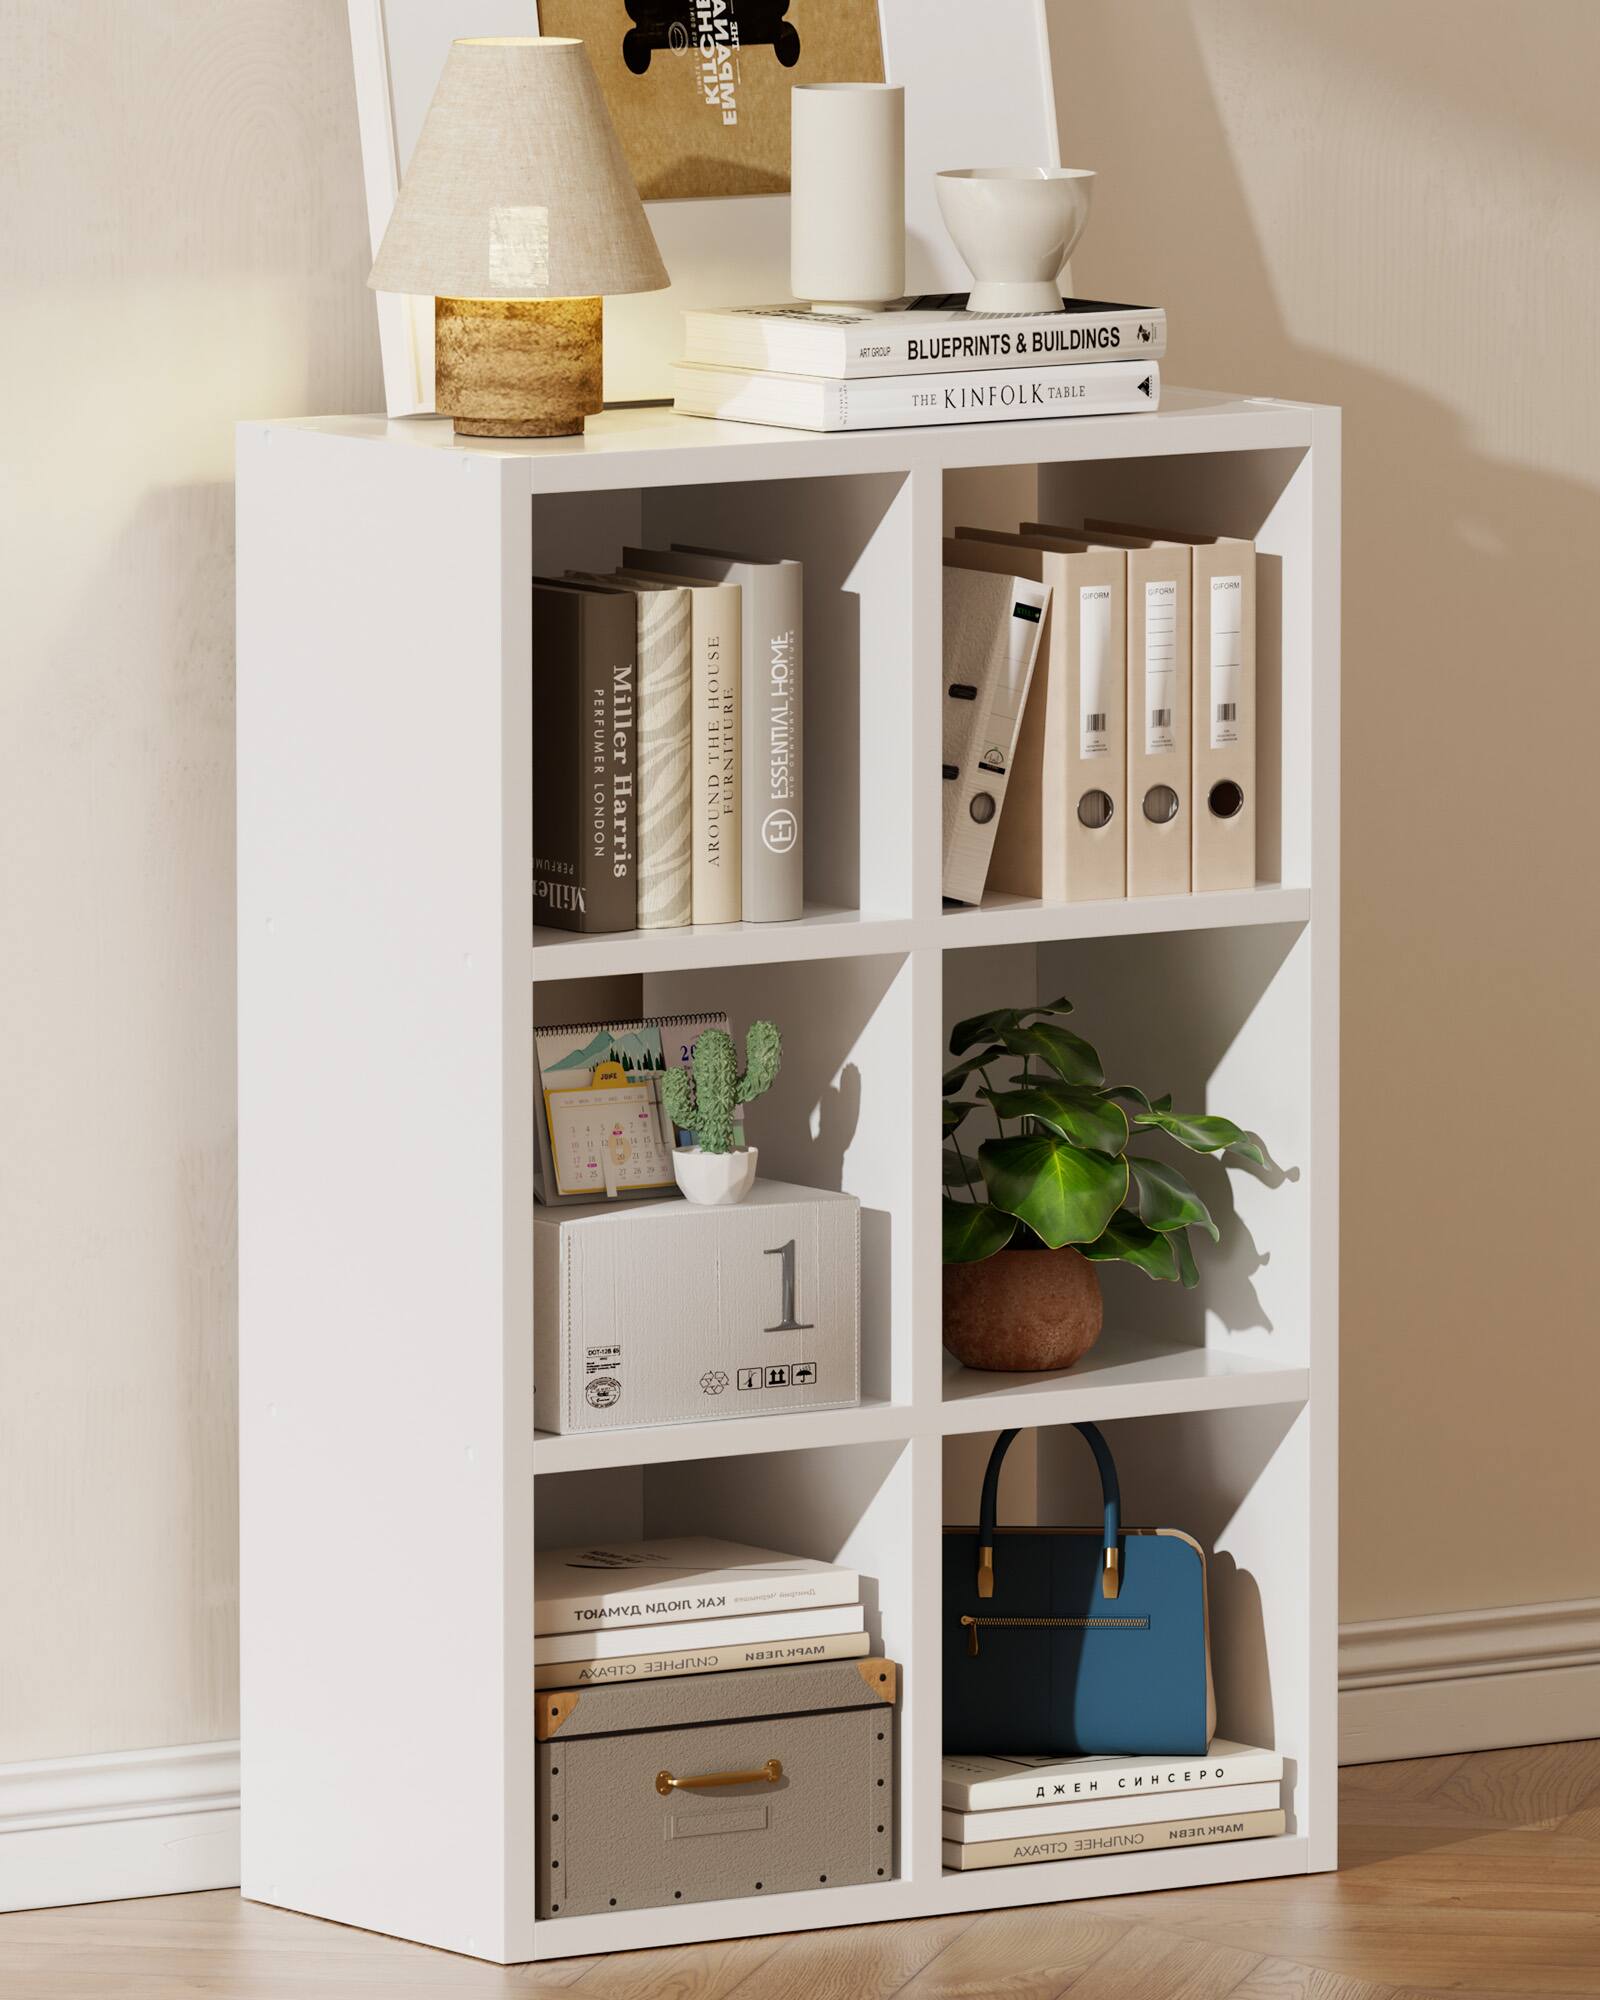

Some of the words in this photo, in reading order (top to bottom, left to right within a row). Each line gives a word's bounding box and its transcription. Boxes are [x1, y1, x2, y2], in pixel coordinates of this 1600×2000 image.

[860, 348, 870, 359] ART
[872, 346, 891, 358] GROUP
[907, 334, 1011, 362] BLUEPRINTS
[1016, 332, 1028, 354] &
[1032, 326, 1121, 352] BUILDINGS
[912, 394, 937, 407] THE
[944, 382, 1046, 410] KINFOLK
[1048, 386, 1086, 400] TABLE
[708, 636, 720, 710] HOUSE
[771, 632, 790, 696] HOME
[594, 688, 605, 774] PERFUMER
[612, 664, 632, 766] Miller
[707, 720, 720, 764] THE
[723, 687, 734, 816] FURNITURE
[771, 700, 790, 800] ESSENTIAL
[594, 784, 605, 858] LONDON
[612, 772, 632, 879] Harris
[706, 774, 720, 868] AROUND
[764, 1239, 814, 1332] 1
[1036, 1781, 1098, 1798] ДЖЕН
[1118, 1768, 1225, 1789] СИНСЕРО
